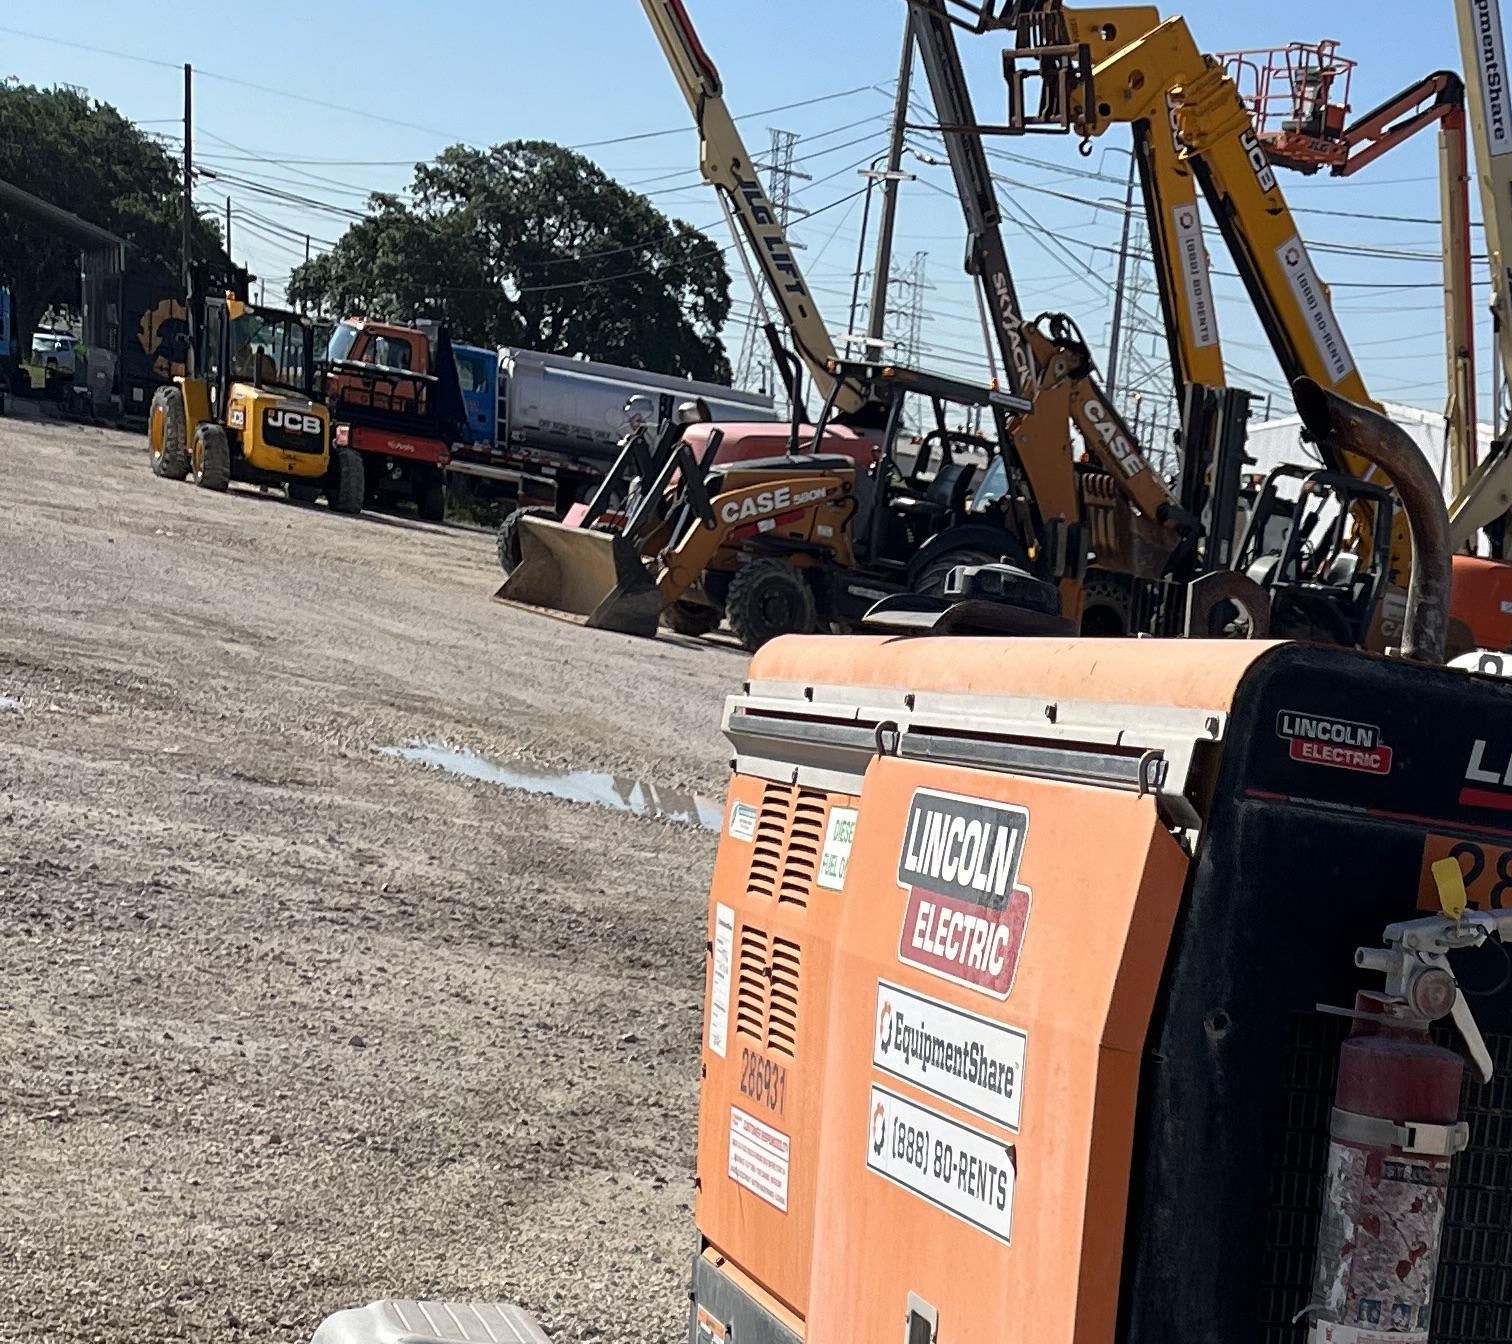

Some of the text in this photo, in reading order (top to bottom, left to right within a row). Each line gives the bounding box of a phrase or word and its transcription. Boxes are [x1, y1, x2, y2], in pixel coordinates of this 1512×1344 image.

[1240, 128, 1276, 193] JCB
[737, 174, 808, 297] JLG LIFT
[991, 271, 1033, 392] SKYJACK
[267, 409, 321, 434] JCB
[1083, 399, 1145, 479] CASE
[721, 486, 791, 523] CASE
[1282, 715, 1375, 748] LINCOLN
[1300, 741, 1382, 770] ELECTRIC
[832, 818, 856, 844] DIESE
[904, 806, 1020, 898] LINCOLN
[912, 900, 1011, 977] ELECTRIC
[740, 1047, 788, 1113] 286931
[894, 1011, 1014, 1099] EquipmentShare
[891, 1115, 1010, 1212] (888) 80-RENTS
